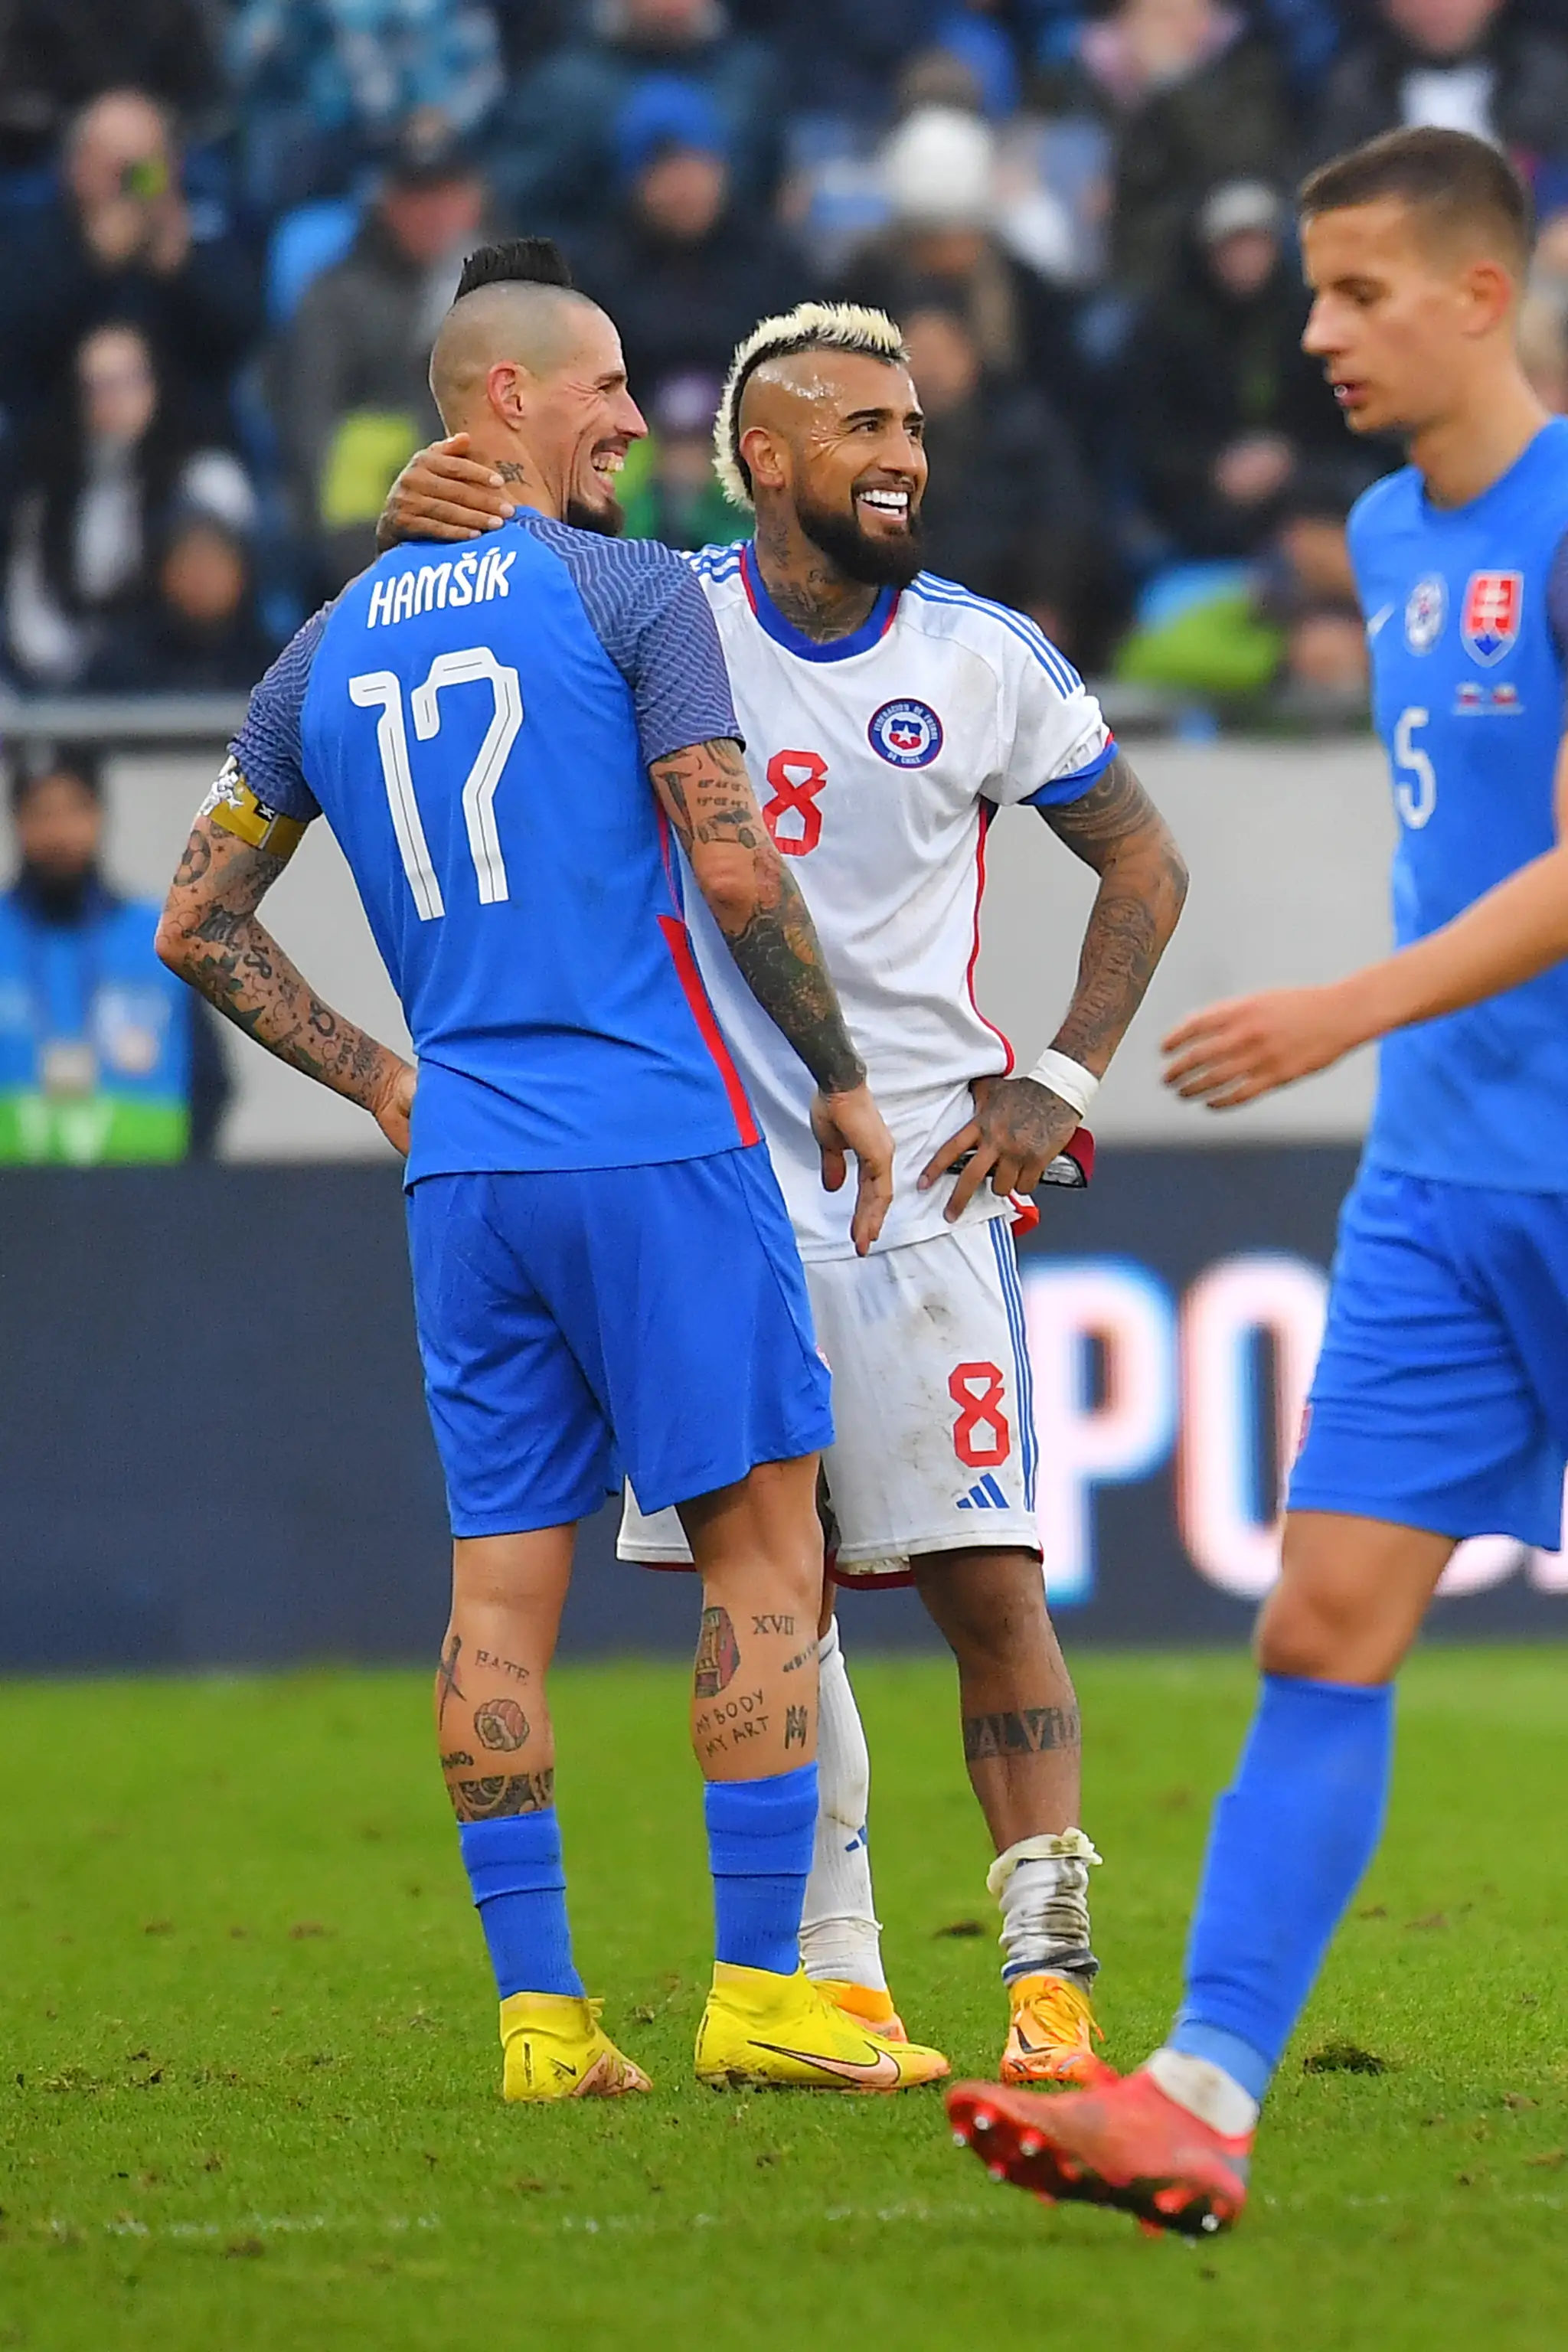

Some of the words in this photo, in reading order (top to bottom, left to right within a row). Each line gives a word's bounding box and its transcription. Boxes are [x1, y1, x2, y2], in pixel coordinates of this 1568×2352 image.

[367, 547, 517, 629] HAMŠÍK
[348, 646, 524, 922] 17
[763, 749, 829, 858] 8
[1394, 706, 1436, 830] 5
[949, 1361, 1011, 1468] 8
[751, 1614, 795, 1636] XVII
[713, 1688, 763, 1725] BODY
[731, 1715, 769, 1745] ART
